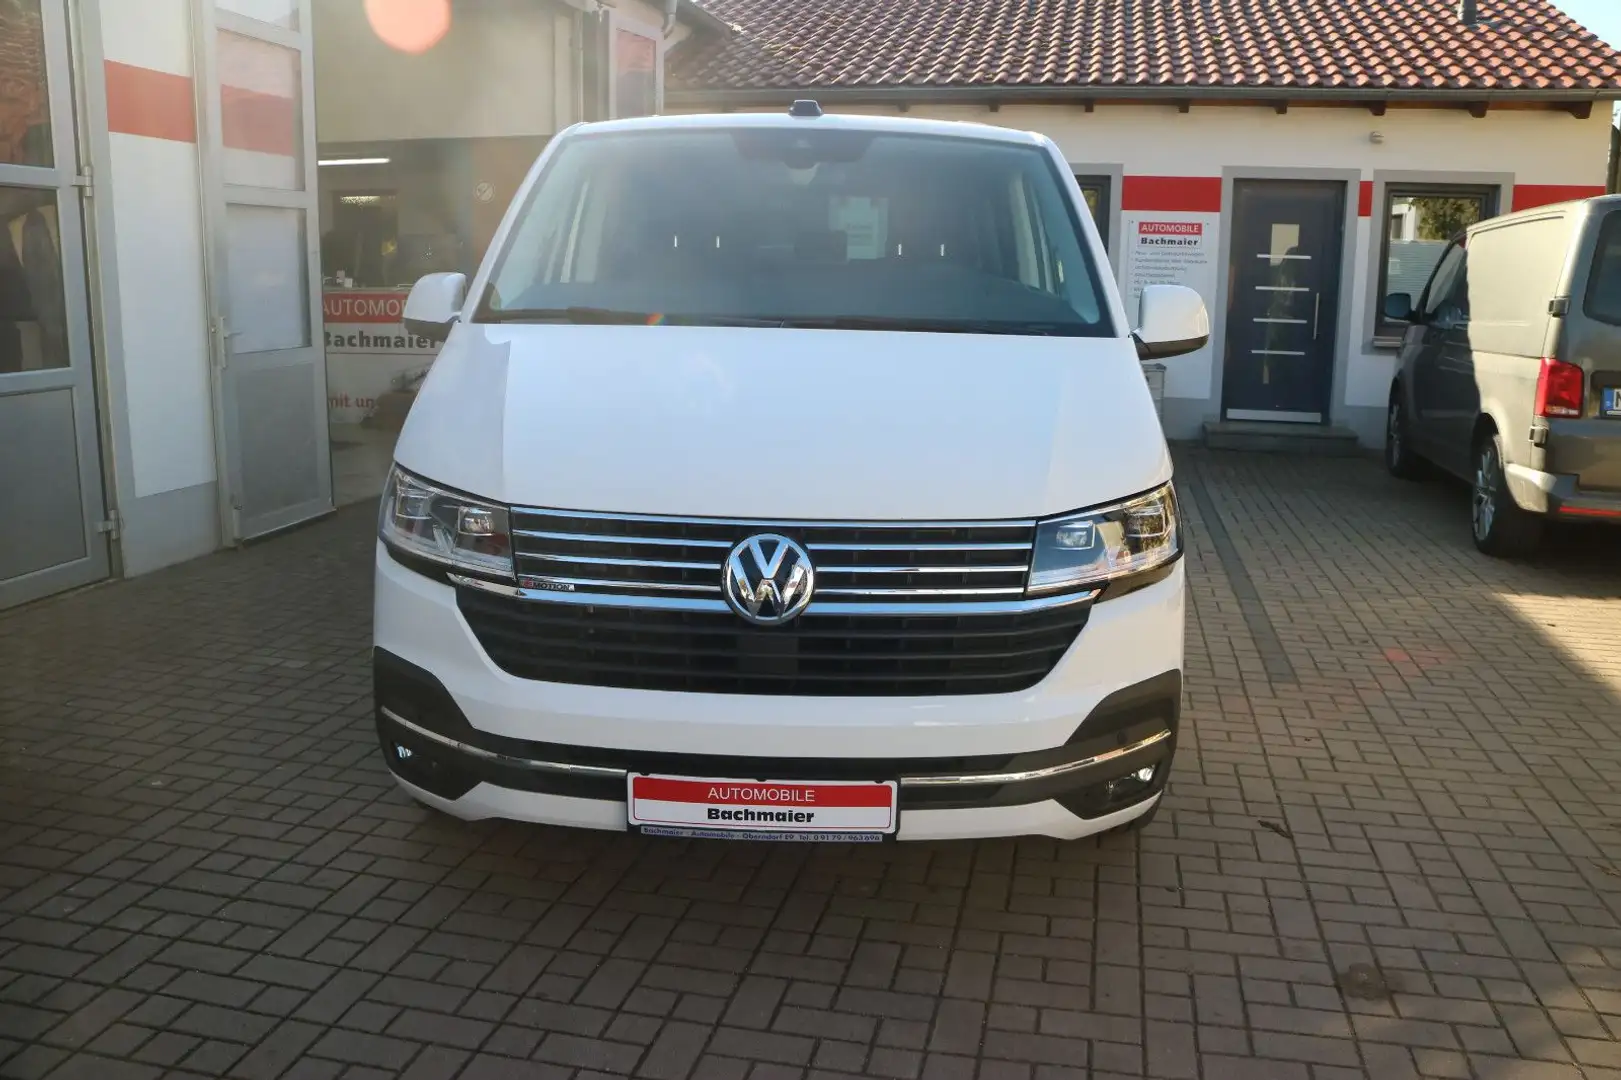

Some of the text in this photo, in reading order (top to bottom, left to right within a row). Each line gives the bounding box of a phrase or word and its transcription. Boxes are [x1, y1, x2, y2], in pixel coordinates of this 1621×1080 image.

[1140, 224, 1199, 233] AUTOMOBILE
[1140, 237, 1199, 246] Bachmaier
[323, 299, 404, 316] AUTOMO
[707, 787, 816, 802] AUTOMOBILE
[707, 808, 815, 823] Bachmaier
